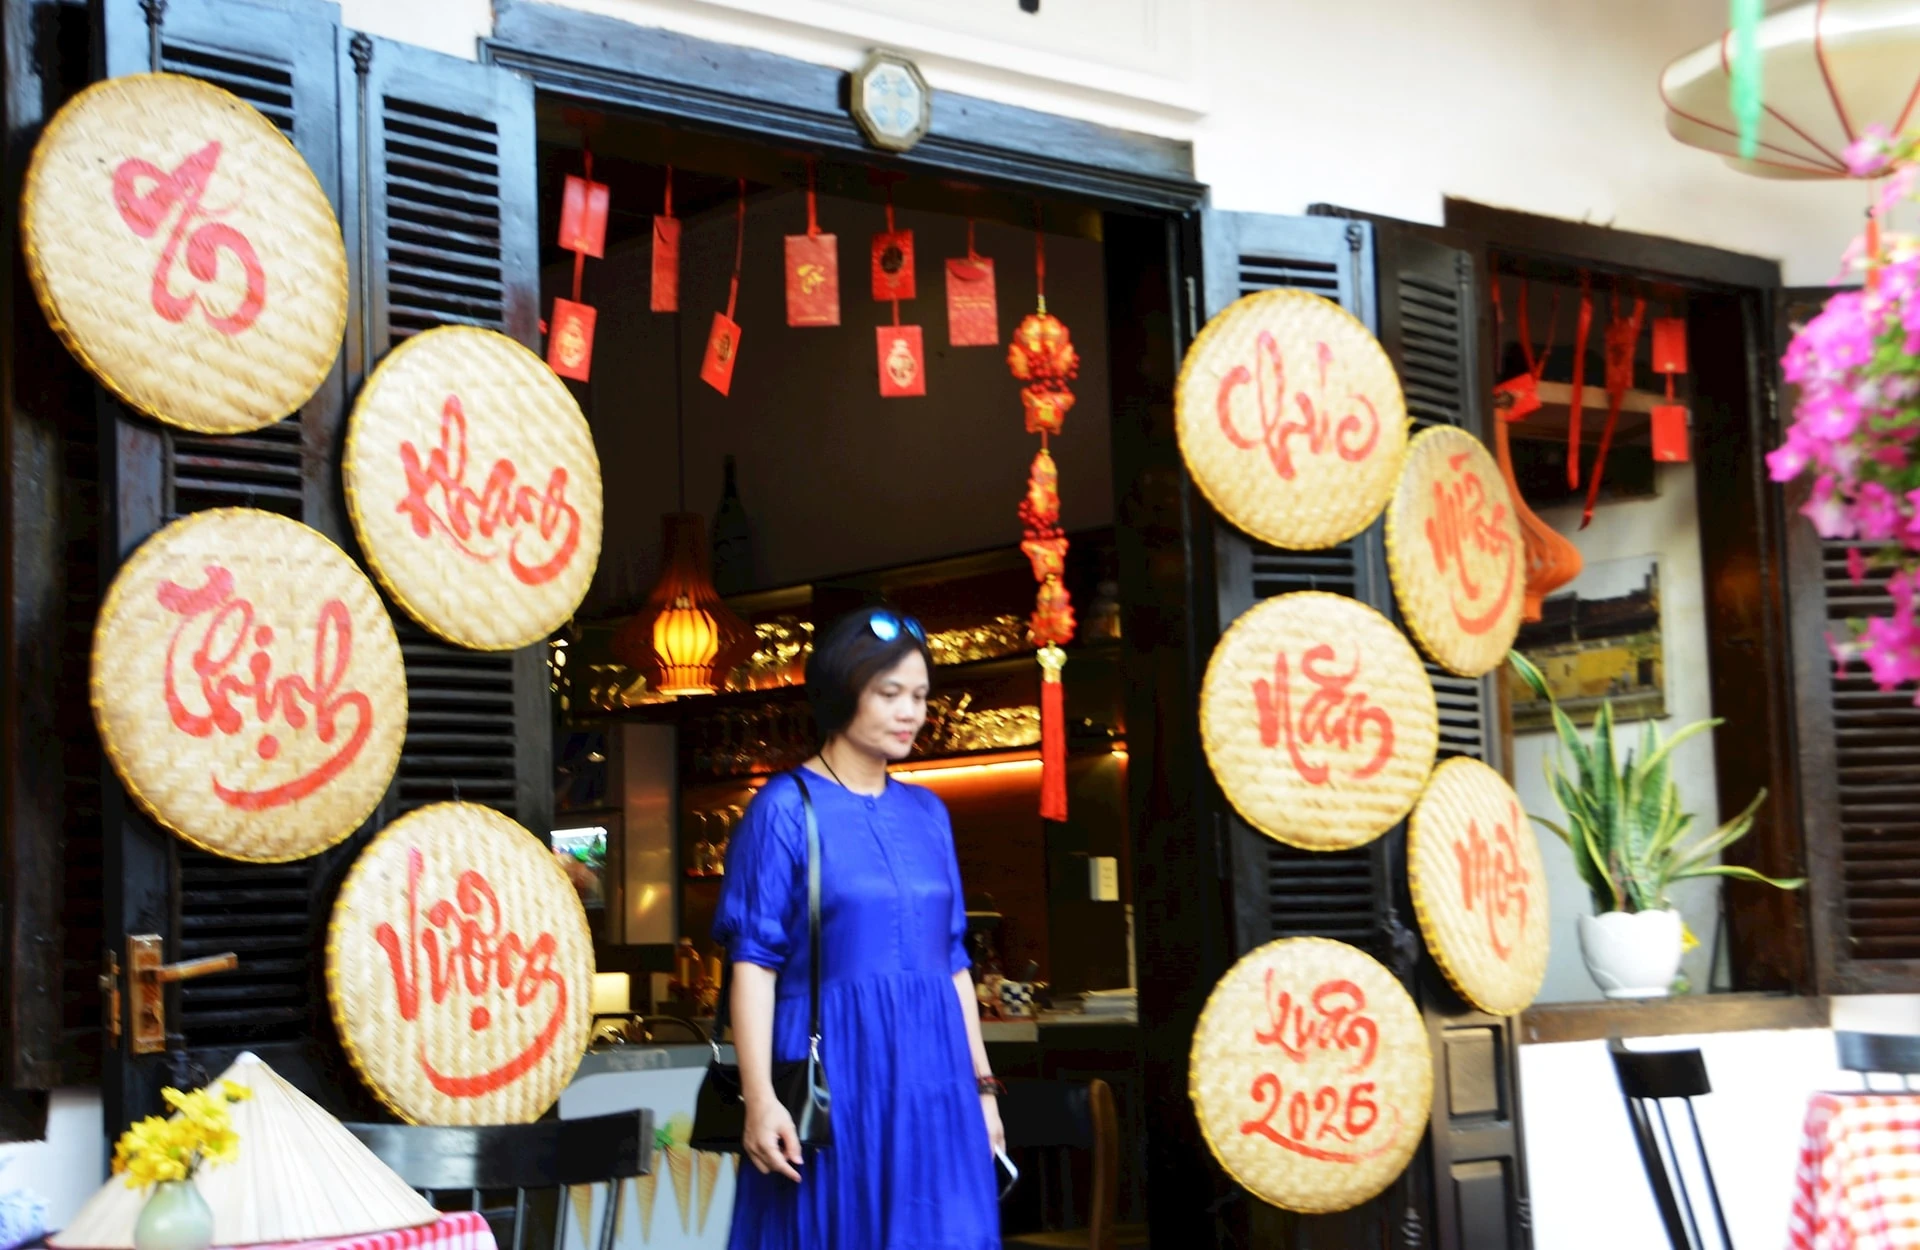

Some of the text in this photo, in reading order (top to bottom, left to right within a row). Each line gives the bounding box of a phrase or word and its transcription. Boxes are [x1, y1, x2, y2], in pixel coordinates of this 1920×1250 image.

[396, 395, 581, 586] Khang
[1216, 331, 1381, 481] Chúc
[156, 565, 374, 812] Thịnh
[1251, 640, 1396, 786] Năm
[374, 847, 569, 1100] Vượng
[1255, 967, 1380, 1075] Xuân
